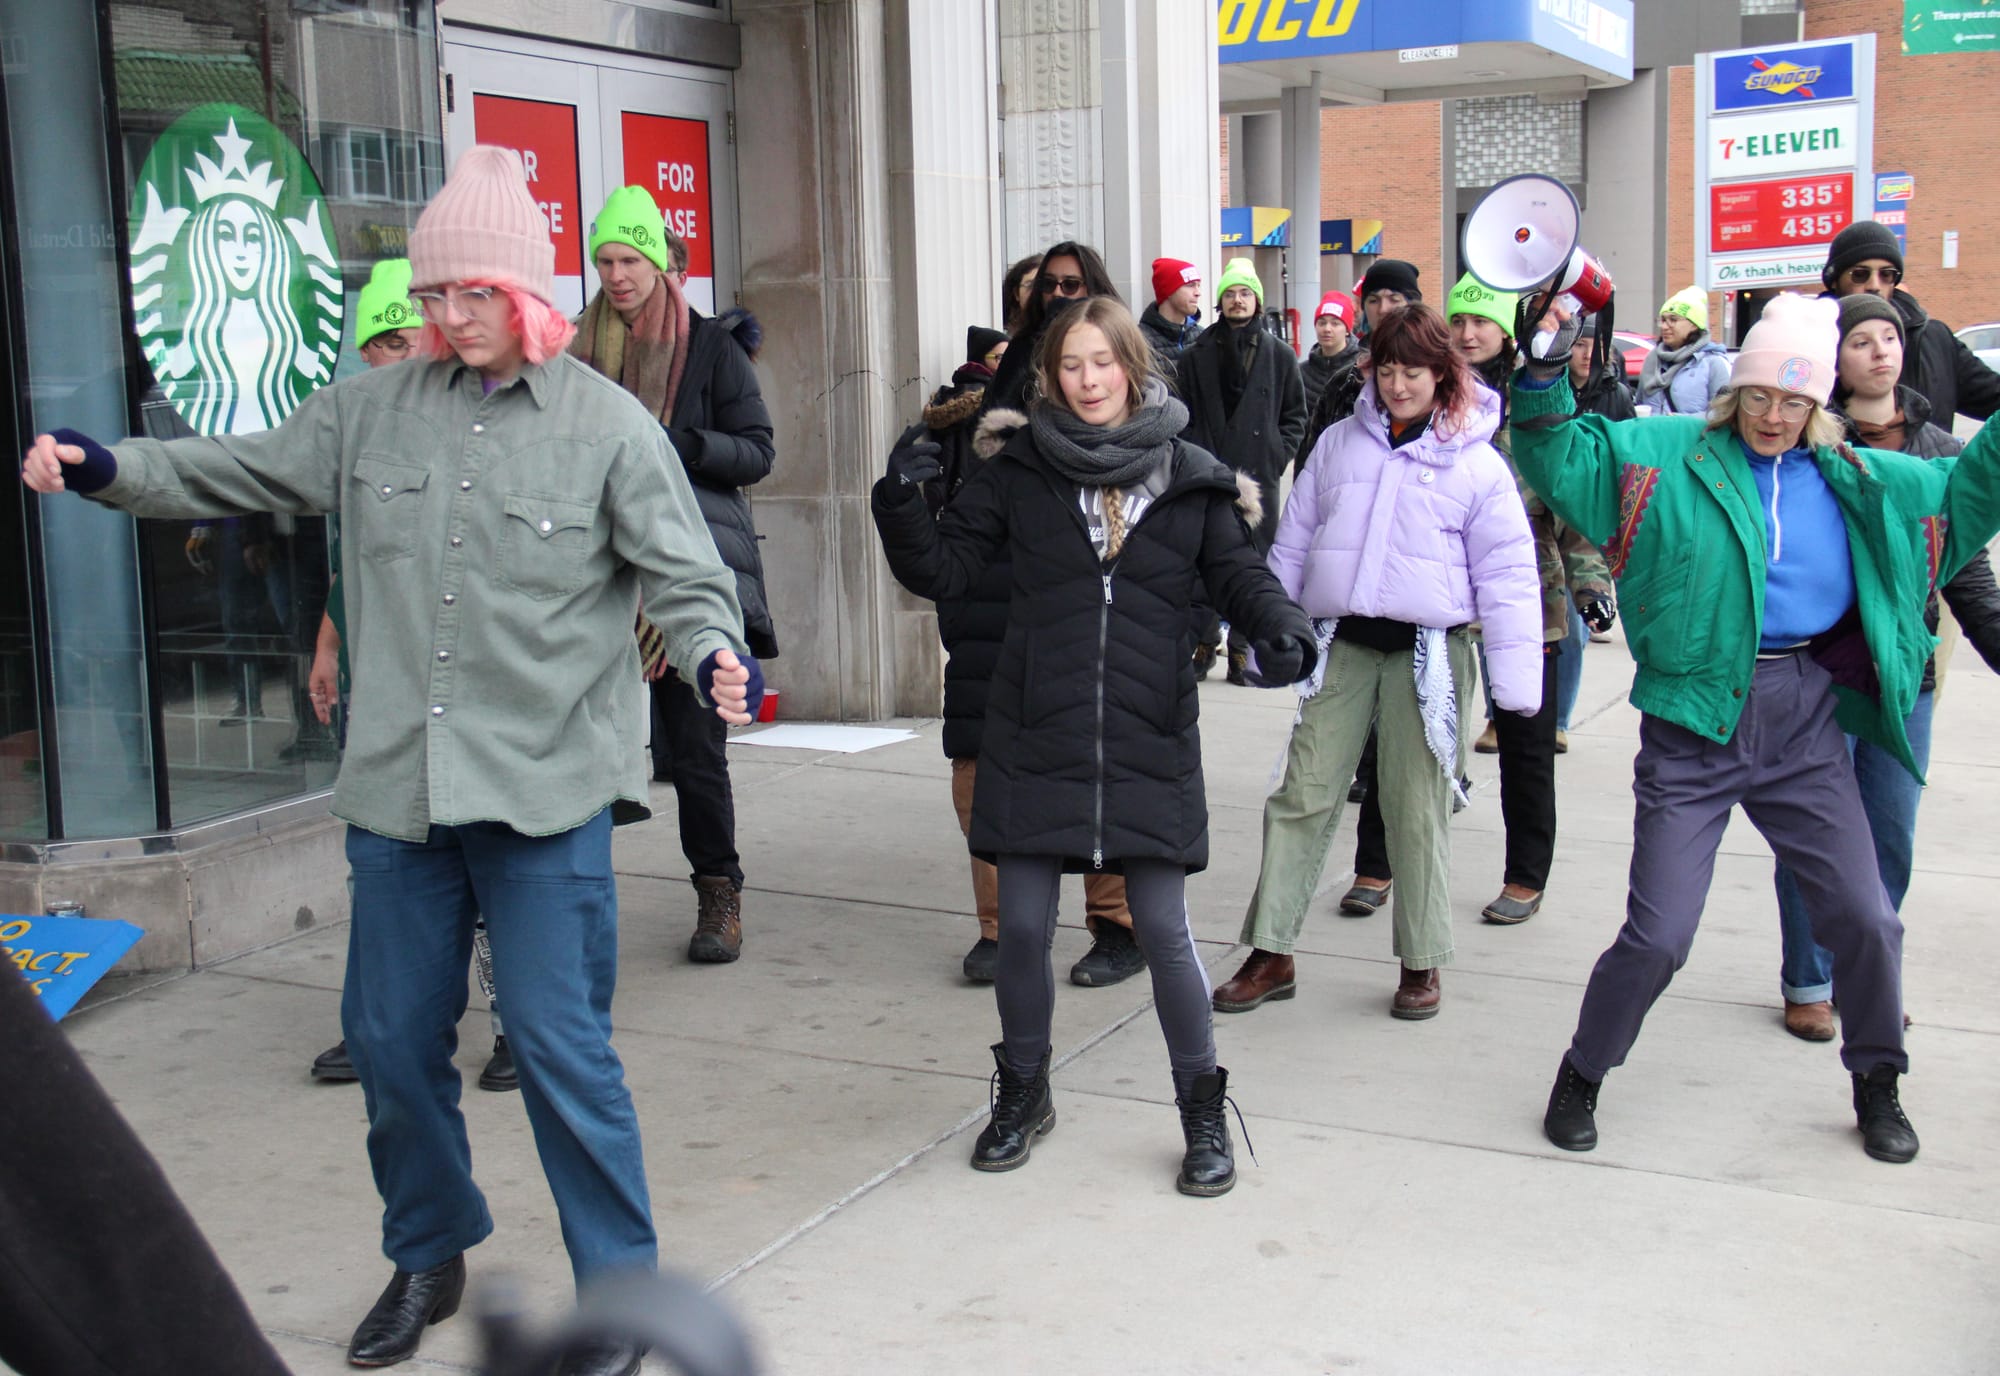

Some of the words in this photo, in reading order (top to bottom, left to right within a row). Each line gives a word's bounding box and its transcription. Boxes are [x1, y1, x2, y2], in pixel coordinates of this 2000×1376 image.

[1750, 69, 1817, 88] SUNOCO
[658, 162, 695, 193] FOR
[657, 207, 697, 239] ASE
[1718, 265, 1741, 280] Oh
[1745, 264, 1784, 278] thank
[0, 920, 32, 942] O
